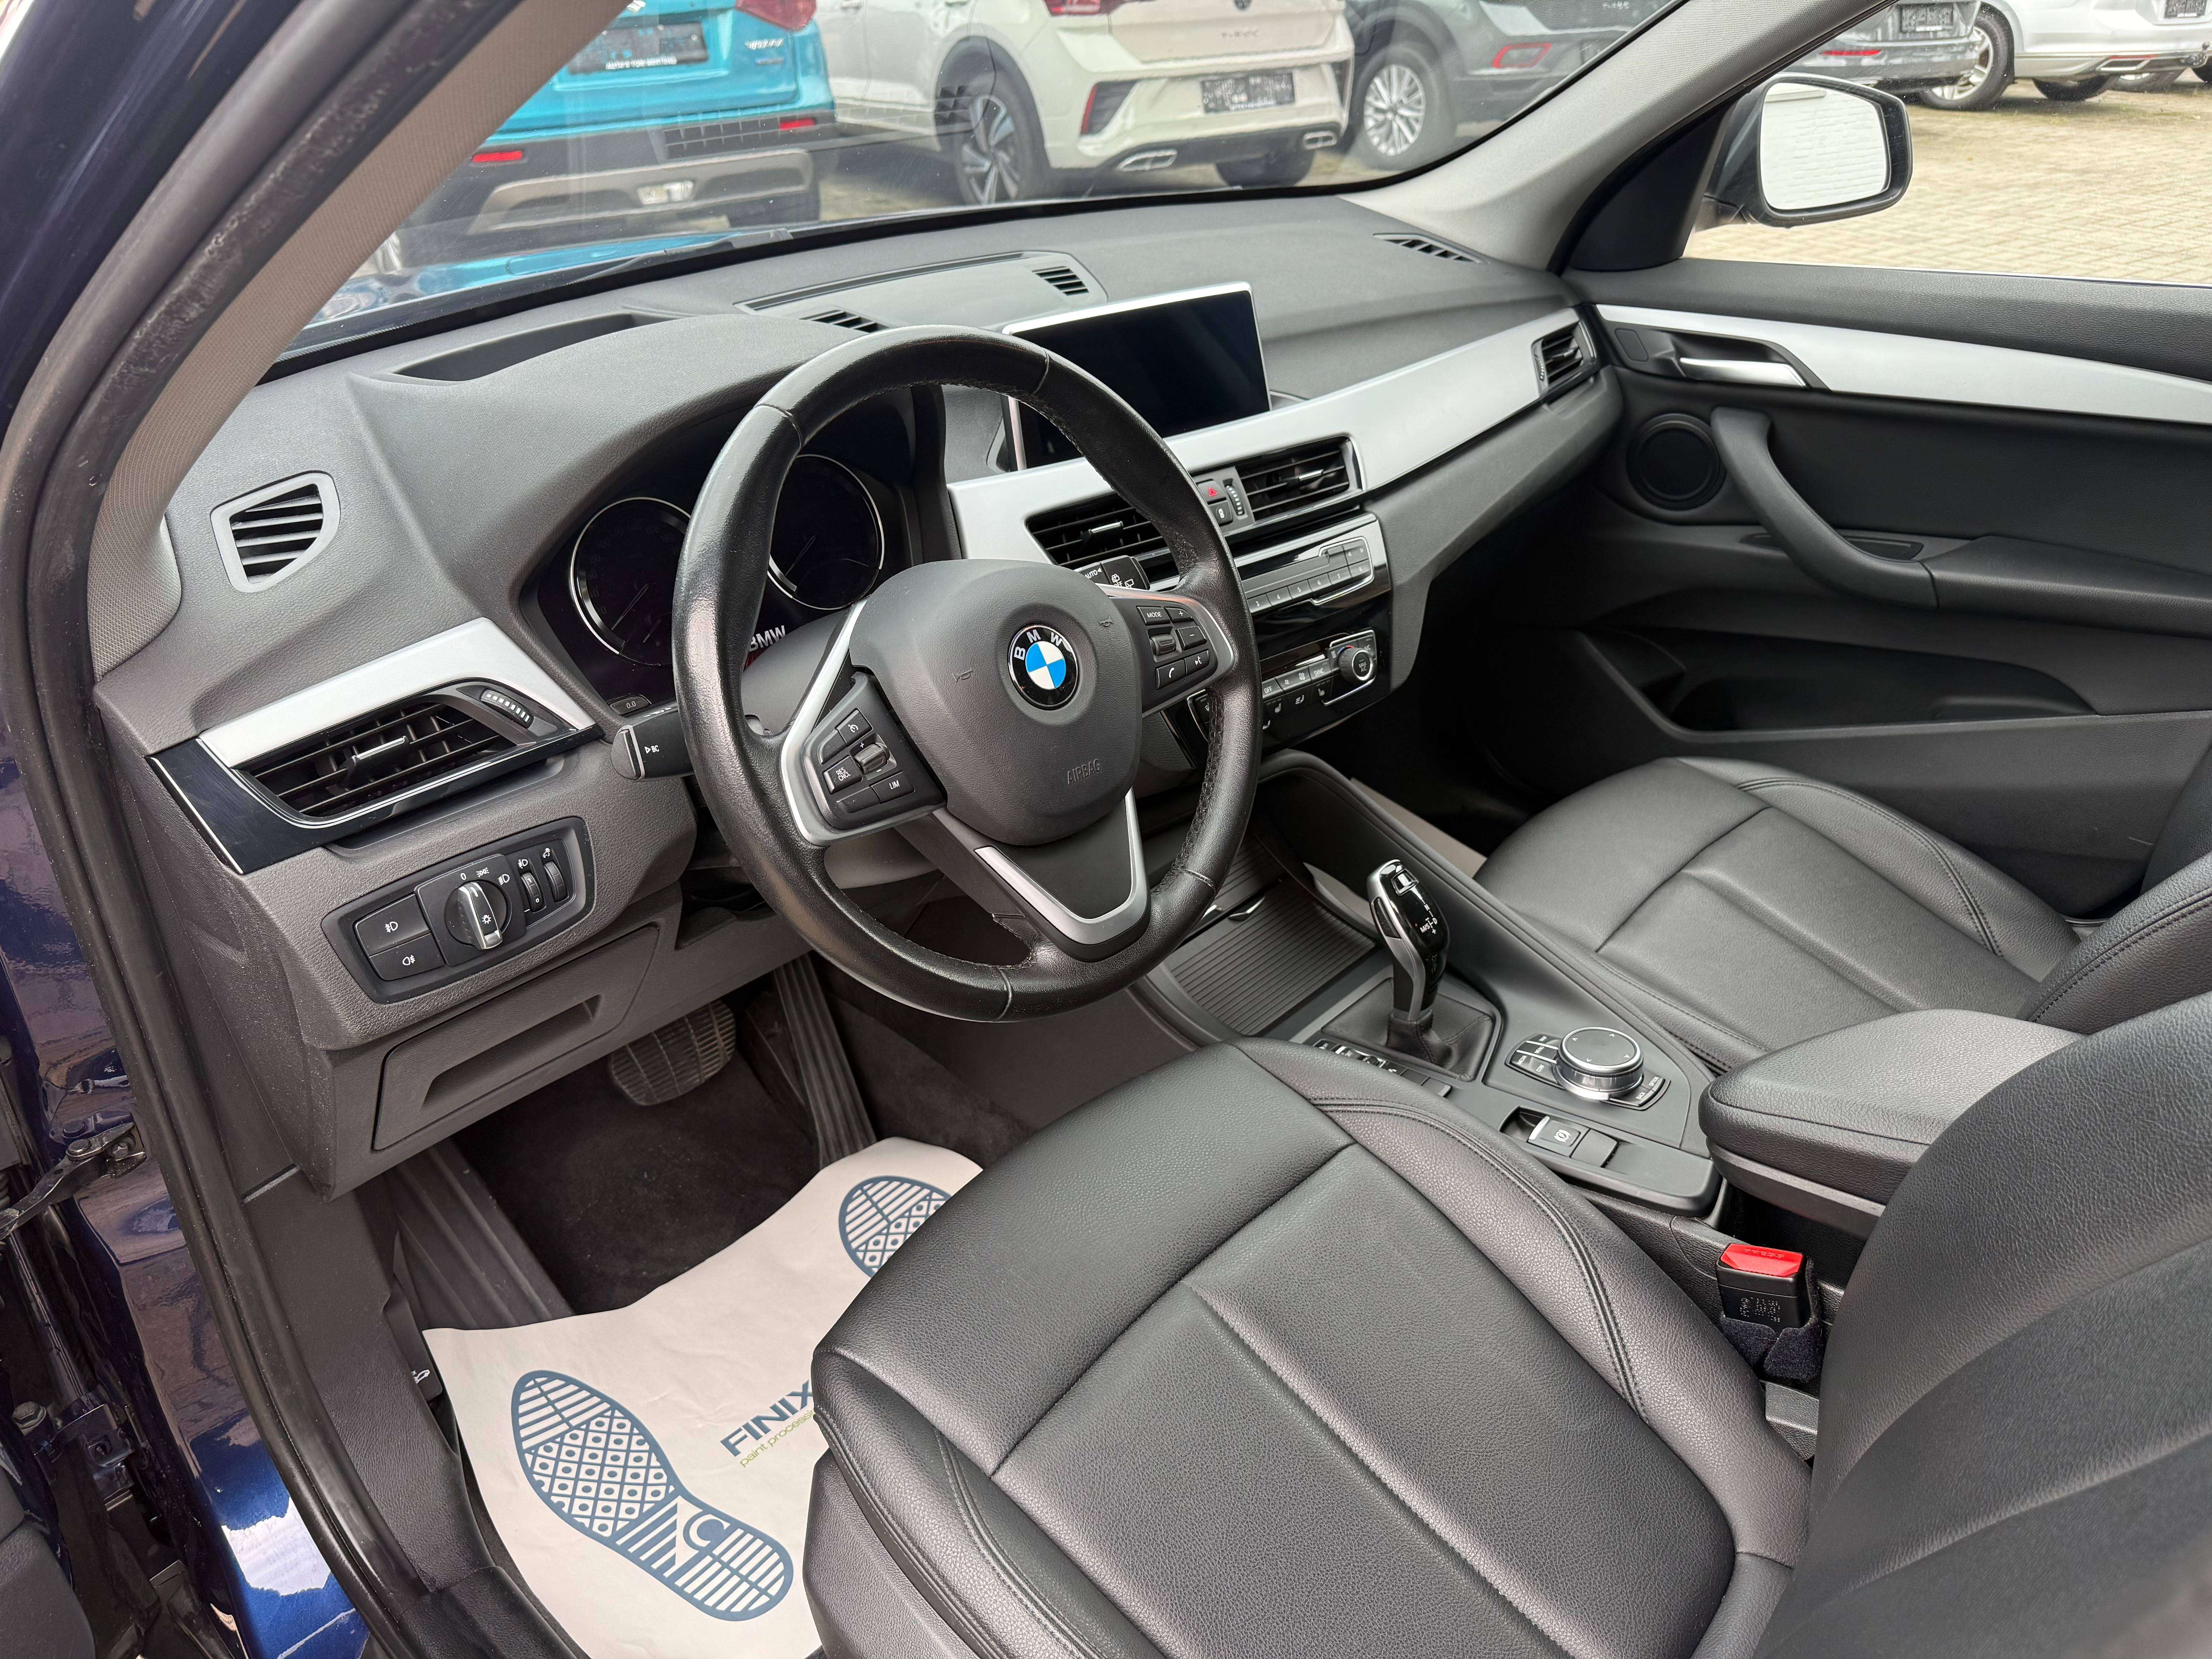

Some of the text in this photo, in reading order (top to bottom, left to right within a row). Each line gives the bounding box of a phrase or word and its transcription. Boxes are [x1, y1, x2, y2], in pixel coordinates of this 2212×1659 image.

[749, 625, 786, 652] BMW
[1014, 629, 1063, 661] BMW
[1314, 668, 1325, 676] SYNC
[1264, 686, 1272, 694] OFF
[626, 701, 636, 709] 0.0
[651, 745, 659, 753] BC
[836, 767, 847, 775] RES
[838, 771, 852, 781] CNCL
[1067, 759, 1101, 785] AIRBAG
[889, 780, 900, 790] LIM
[1419, 923, 1431, 933] M/S
[739, 1443, 768, 1468] paint
